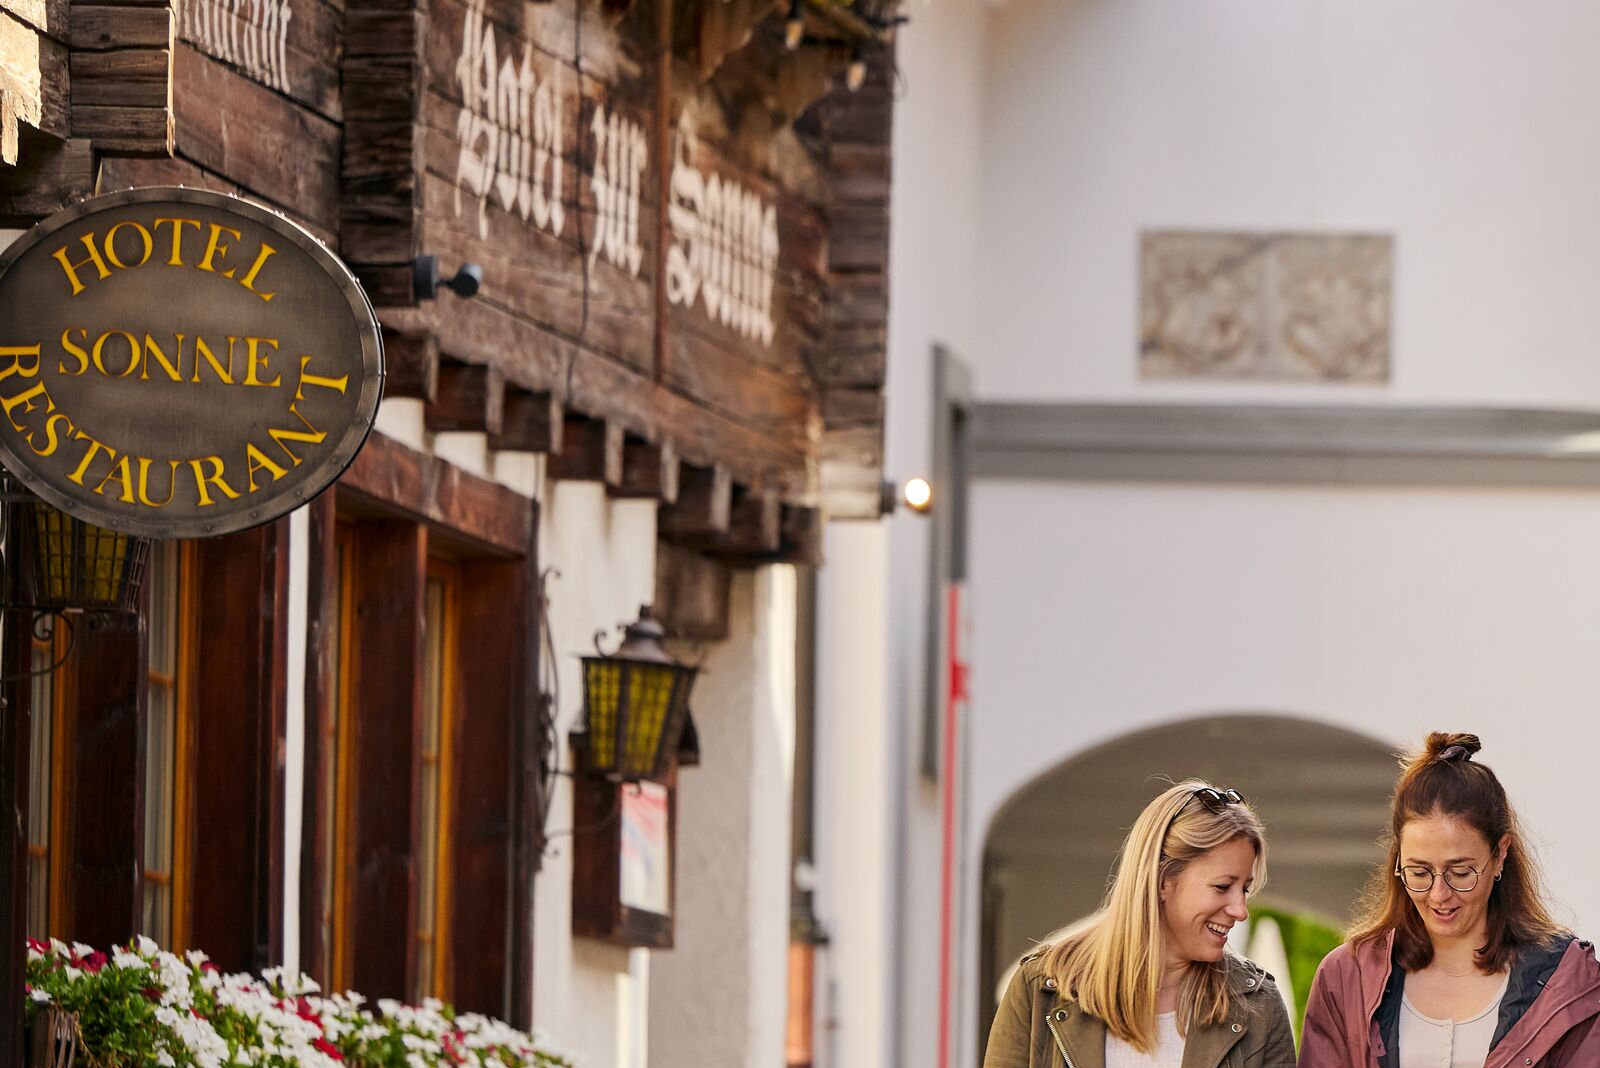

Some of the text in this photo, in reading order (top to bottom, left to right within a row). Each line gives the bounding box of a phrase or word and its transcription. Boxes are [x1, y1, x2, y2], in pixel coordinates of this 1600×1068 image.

[51, 217, 278, 301] HOTEL
[588, 104, 648, 292] zur
[58, 327, 281, 387] SONNE
[0, 341, 349, 507] RESTAURANT
